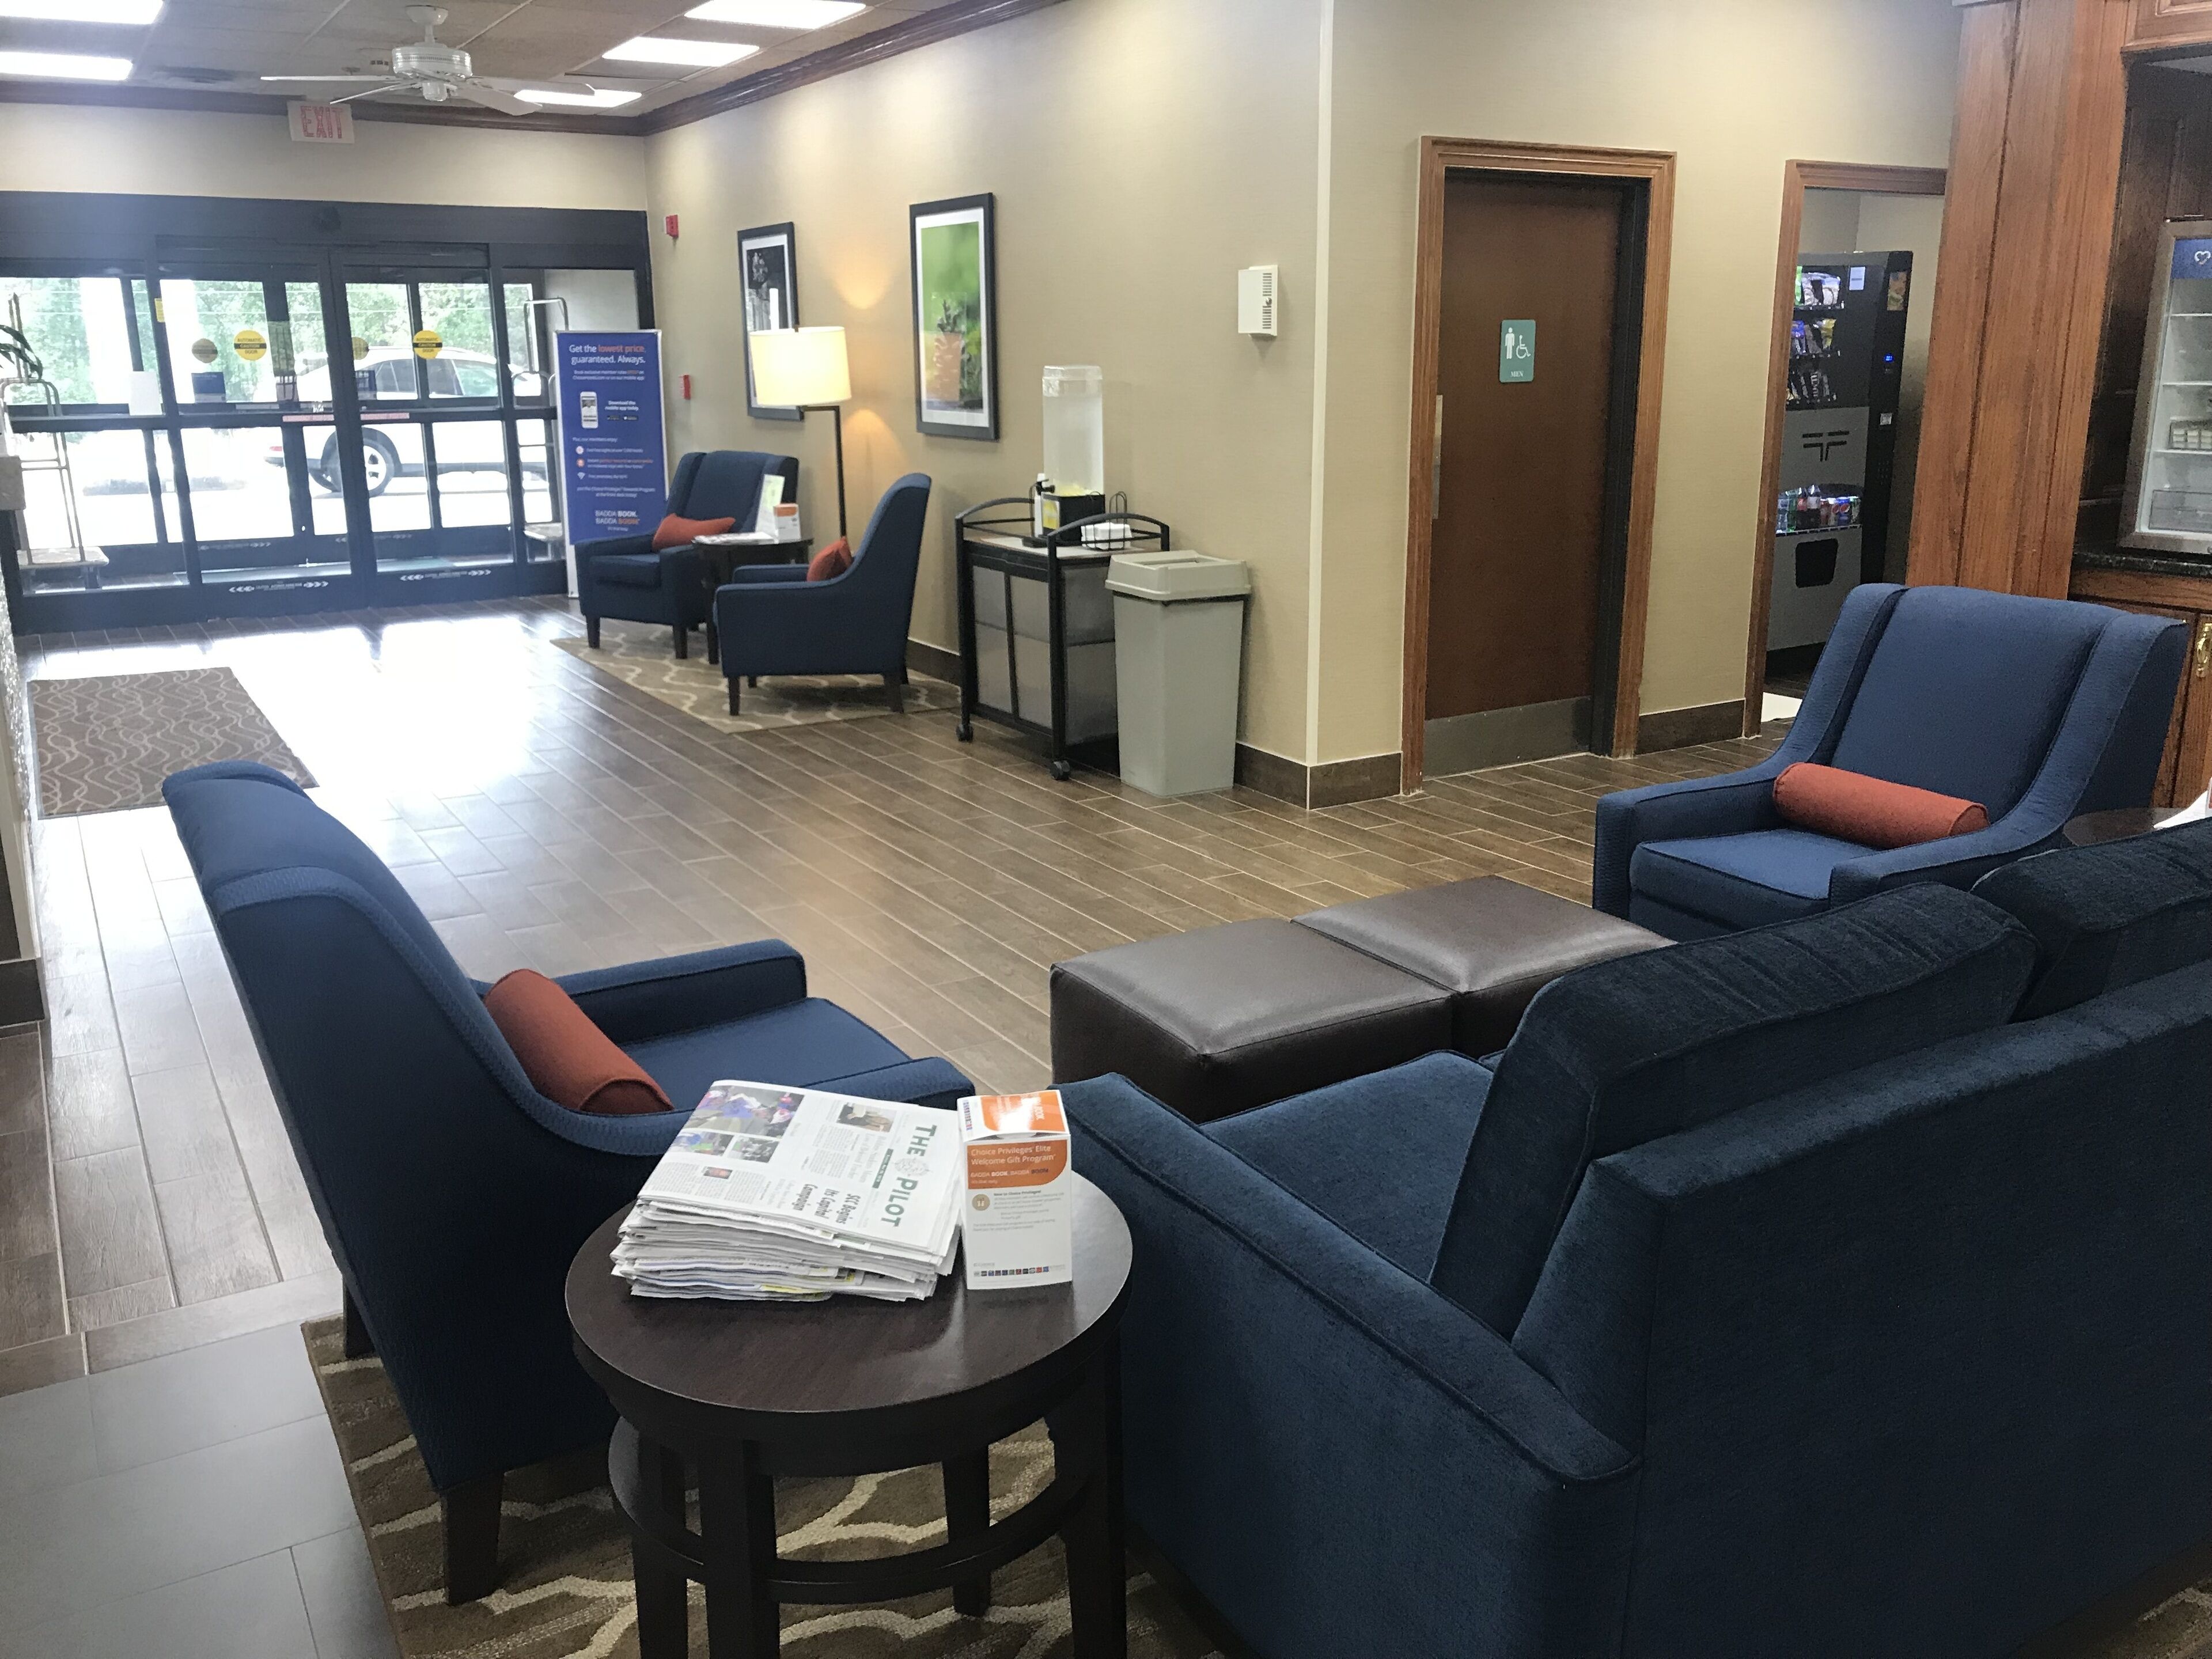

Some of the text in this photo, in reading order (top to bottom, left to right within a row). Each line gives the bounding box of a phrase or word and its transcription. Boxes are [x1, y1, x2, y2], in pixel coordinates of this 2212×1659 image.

[300, 106, 343, 138] EXIT
[569, 344, 583, 353] Get
[584, 344, 597, 353] the
[598, 344, 623, 353] lowest
[571, 355, 646, 365] guaranteed. Always.
[907, 1124, 937, 1157] THE
[1007, 1156, 1021, 1164] Gift
[791, 1184, 819, 1211] Campaign
[815, 1188, 840, 1219] Its Capital
[836, 1193, 861, 1225] SCC Begins
[881, 1177, 919, 1227] PILOT
